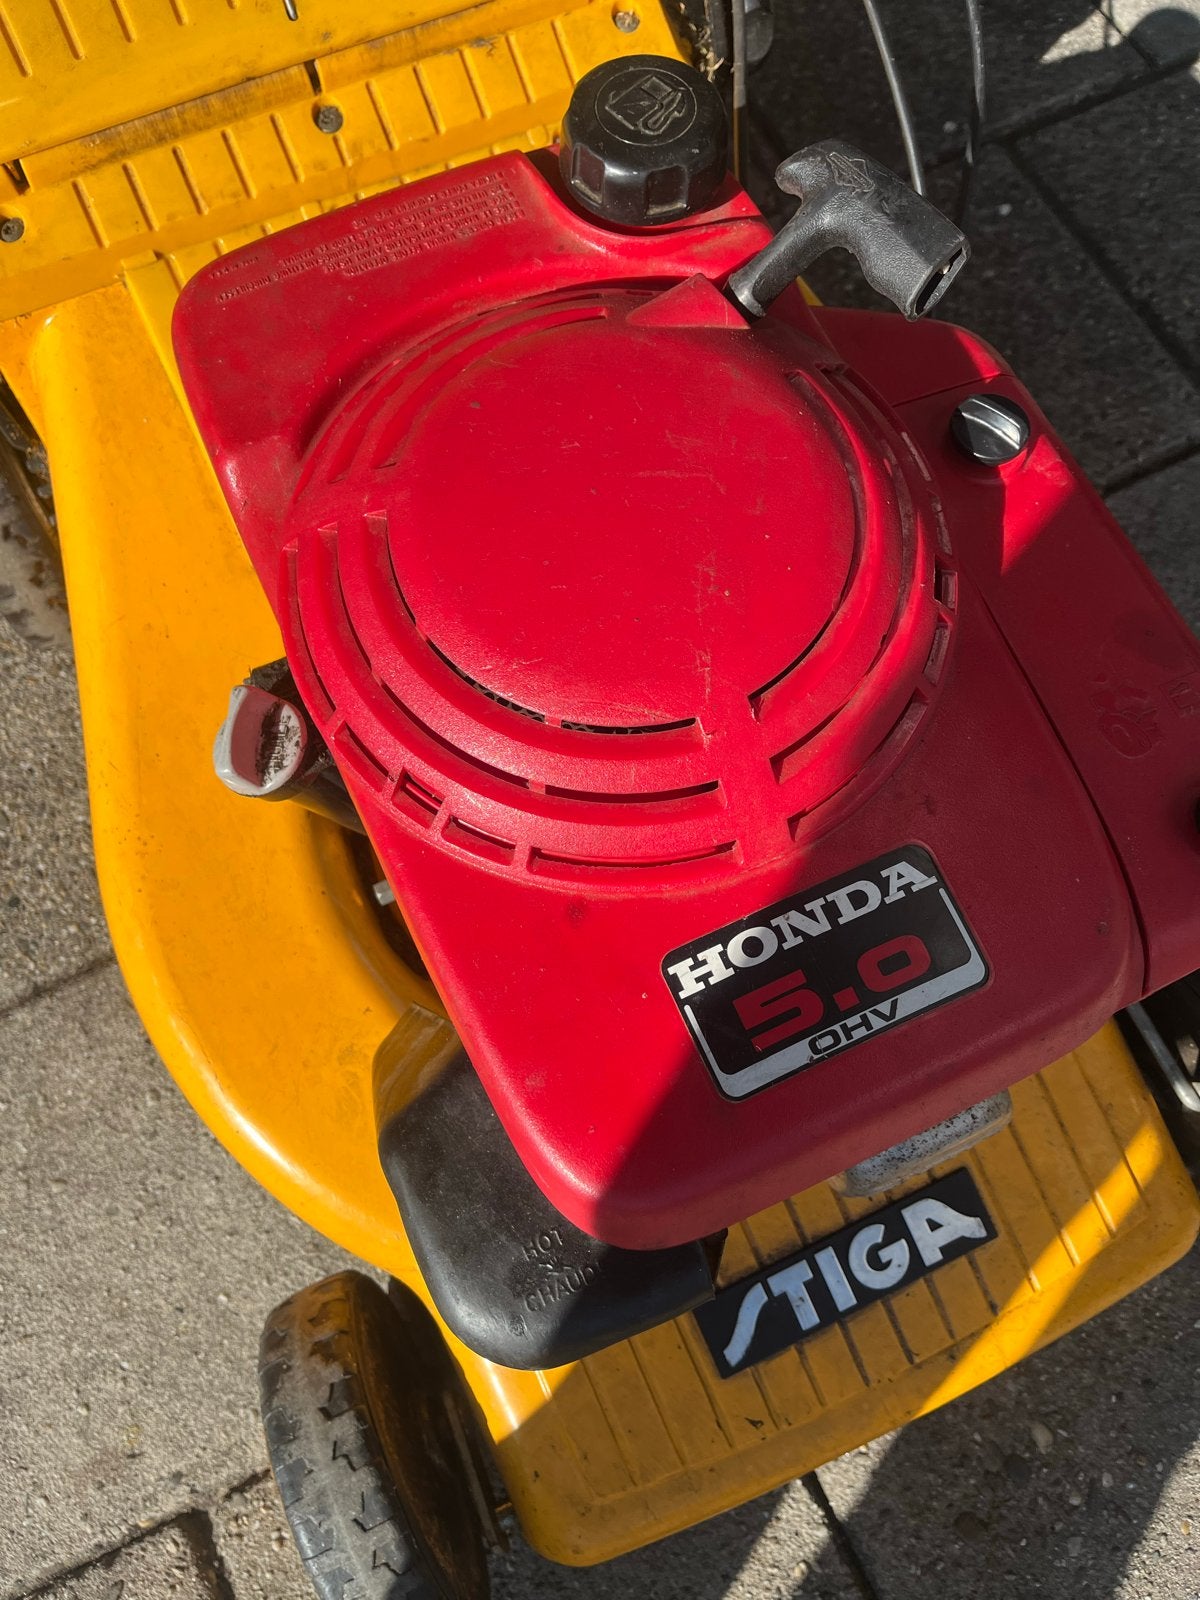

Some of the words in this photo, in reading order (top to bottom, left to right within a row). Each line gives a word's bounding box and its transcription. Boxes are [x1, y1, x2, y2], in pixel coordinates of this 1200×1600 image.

[667, 861, 938, 999] HONDA
[733, 935, 931, 1050] 5.0
[808, 998, 899, 1057] OHV
[521, 1228, 563, 1262] HOT
[723, 1198, 986, 1367] STIGA
